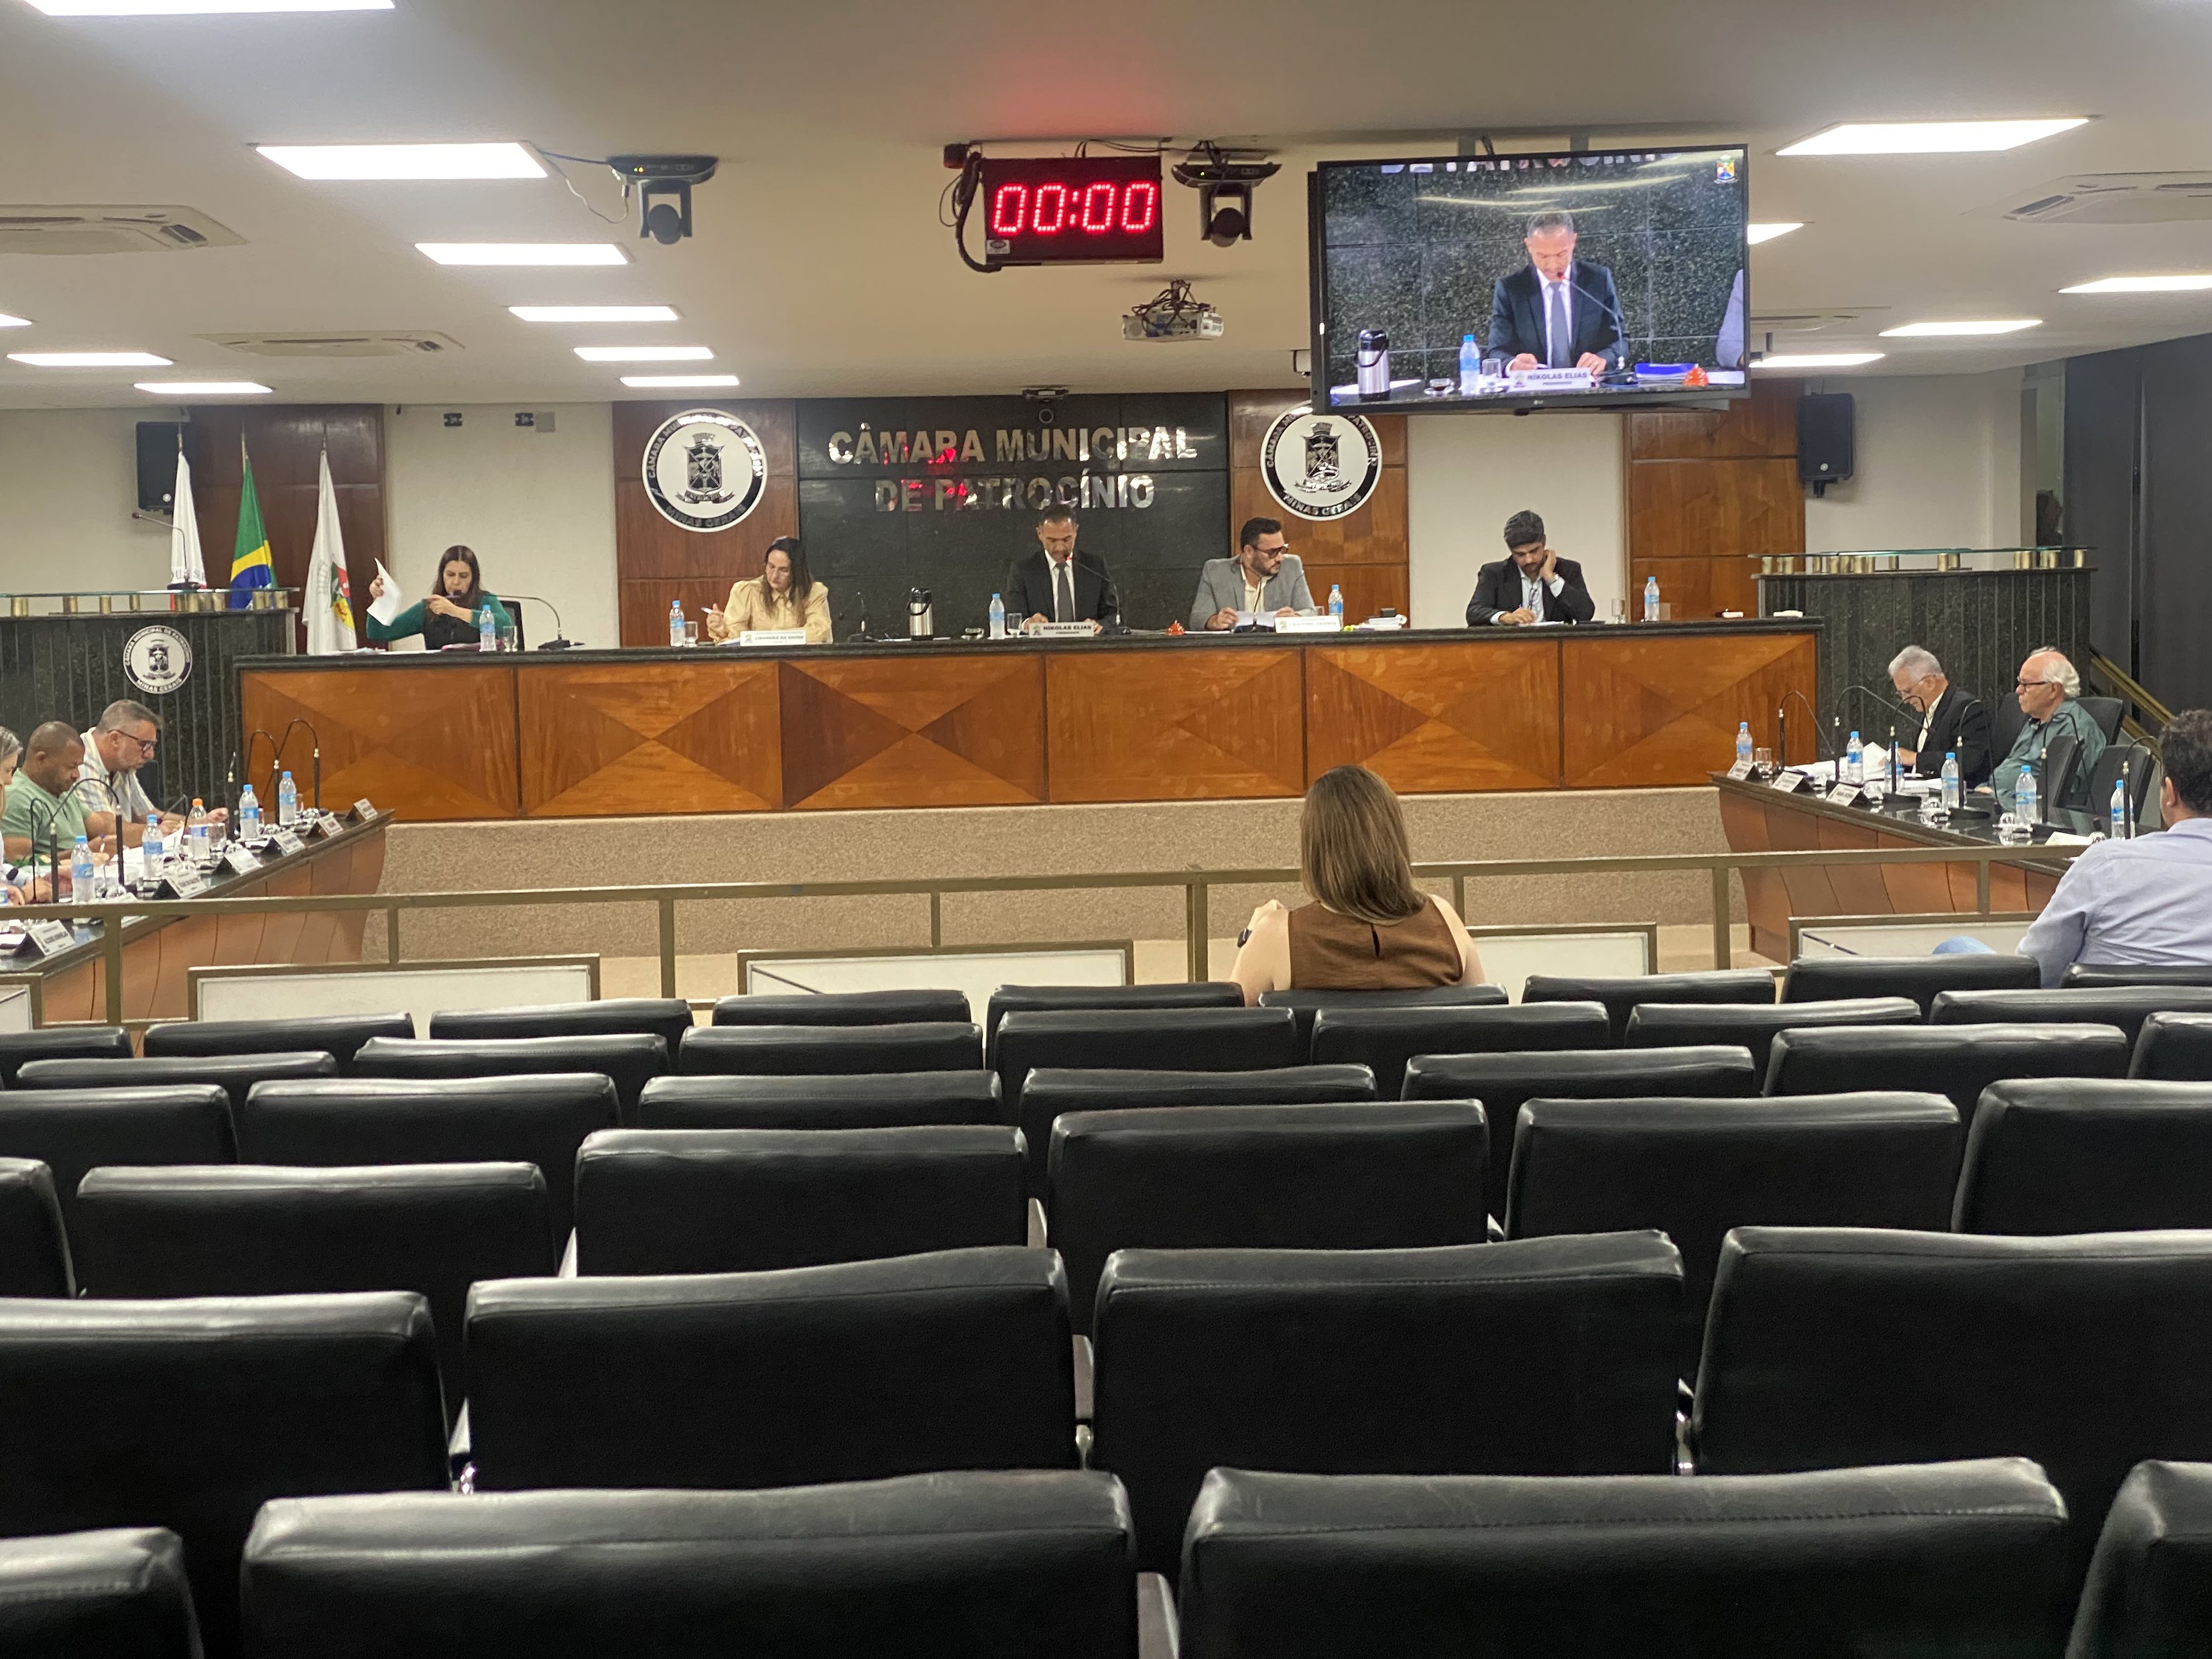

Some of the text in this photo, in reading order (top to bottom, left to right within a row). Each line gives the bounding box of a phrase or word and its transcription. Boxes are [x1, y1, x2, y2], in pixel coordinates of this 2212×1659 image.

[993, 182, 1158, 235] 00:00
[828, 422, 1199, 465] CÂMARA MUNICIPAL
[875, 468, 1156, 512] DE PATROCÍNIO
[1283, 494, 1319, 515] MINAS
